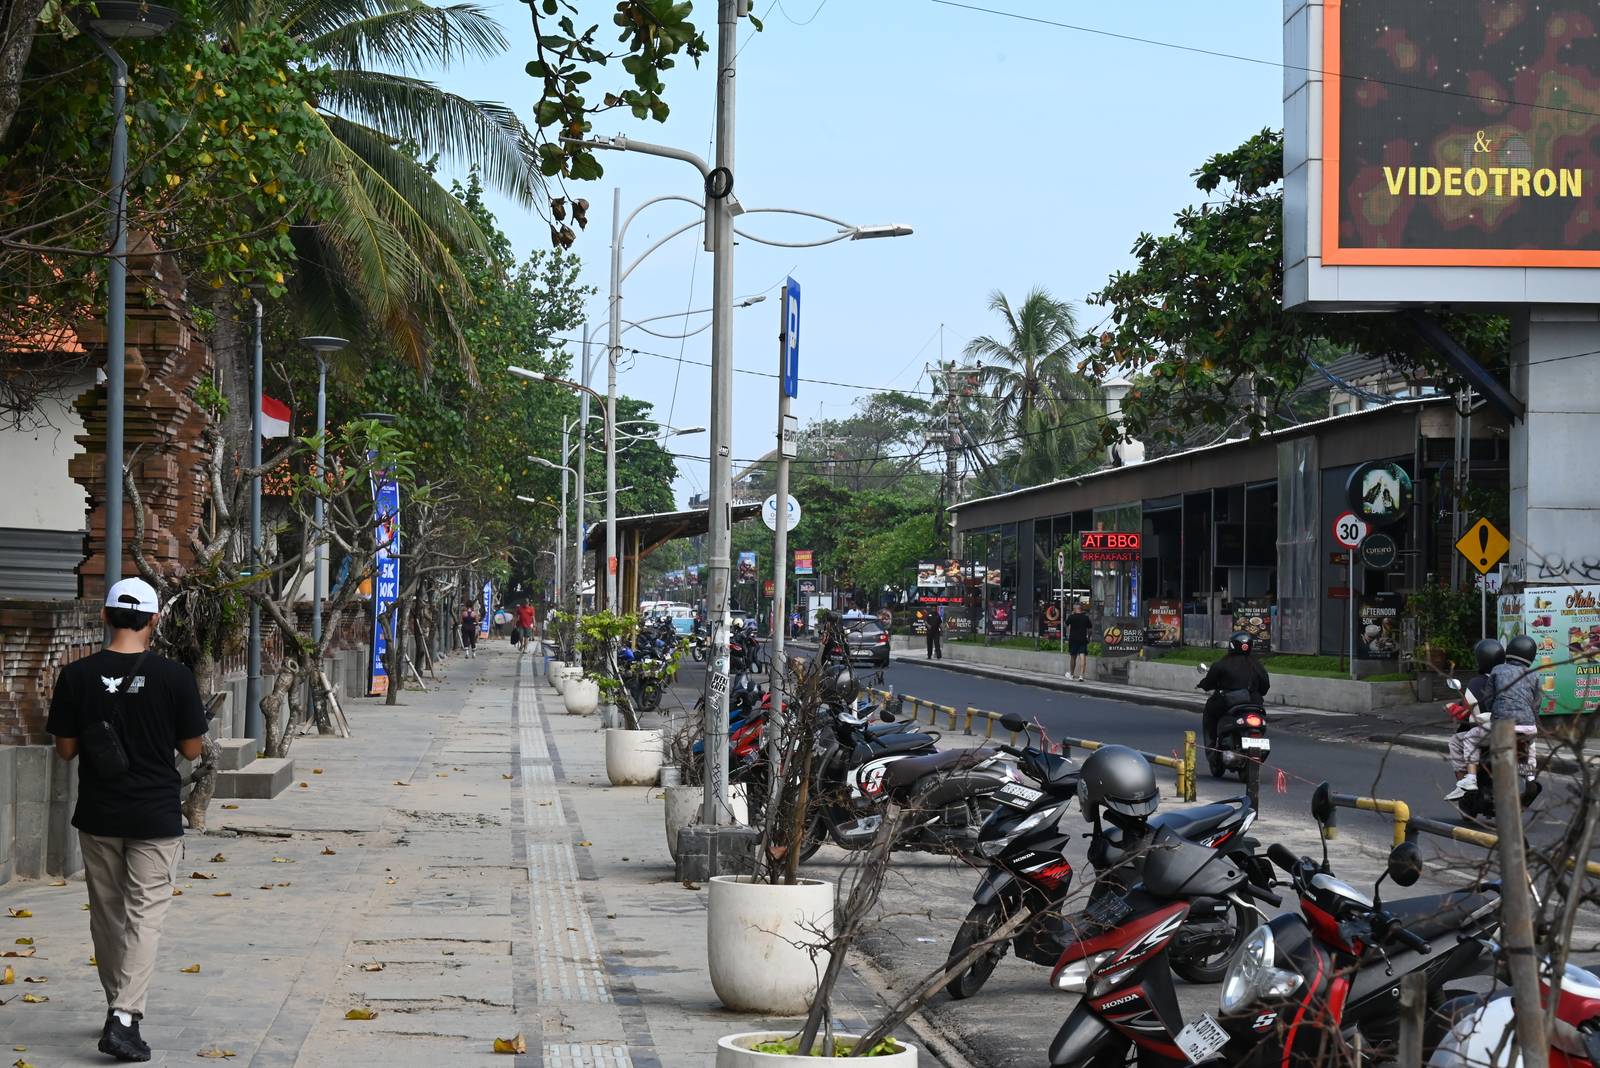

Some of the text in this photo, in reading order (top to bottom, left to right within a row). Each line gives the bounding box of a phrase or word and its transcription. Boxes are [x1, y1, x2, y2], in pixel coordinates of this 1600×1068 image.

[1473, 130, 1492, 153] &
[1383, 167, 1582, 197] VIDEOTRON
[787, 295, 798, 377] P
[1340, 523, 1359, 541] 30
[1107, 535, 1138, 548] BBQ
[382, 563, 394, 578] 5K
[379, 582, 395, 598] 10K
[1362, 607, 1396, 616] AFTERNOON
[1013, 852, 1036, 864] HONDA
[1101, 993, 1140, 1010] HONDA
